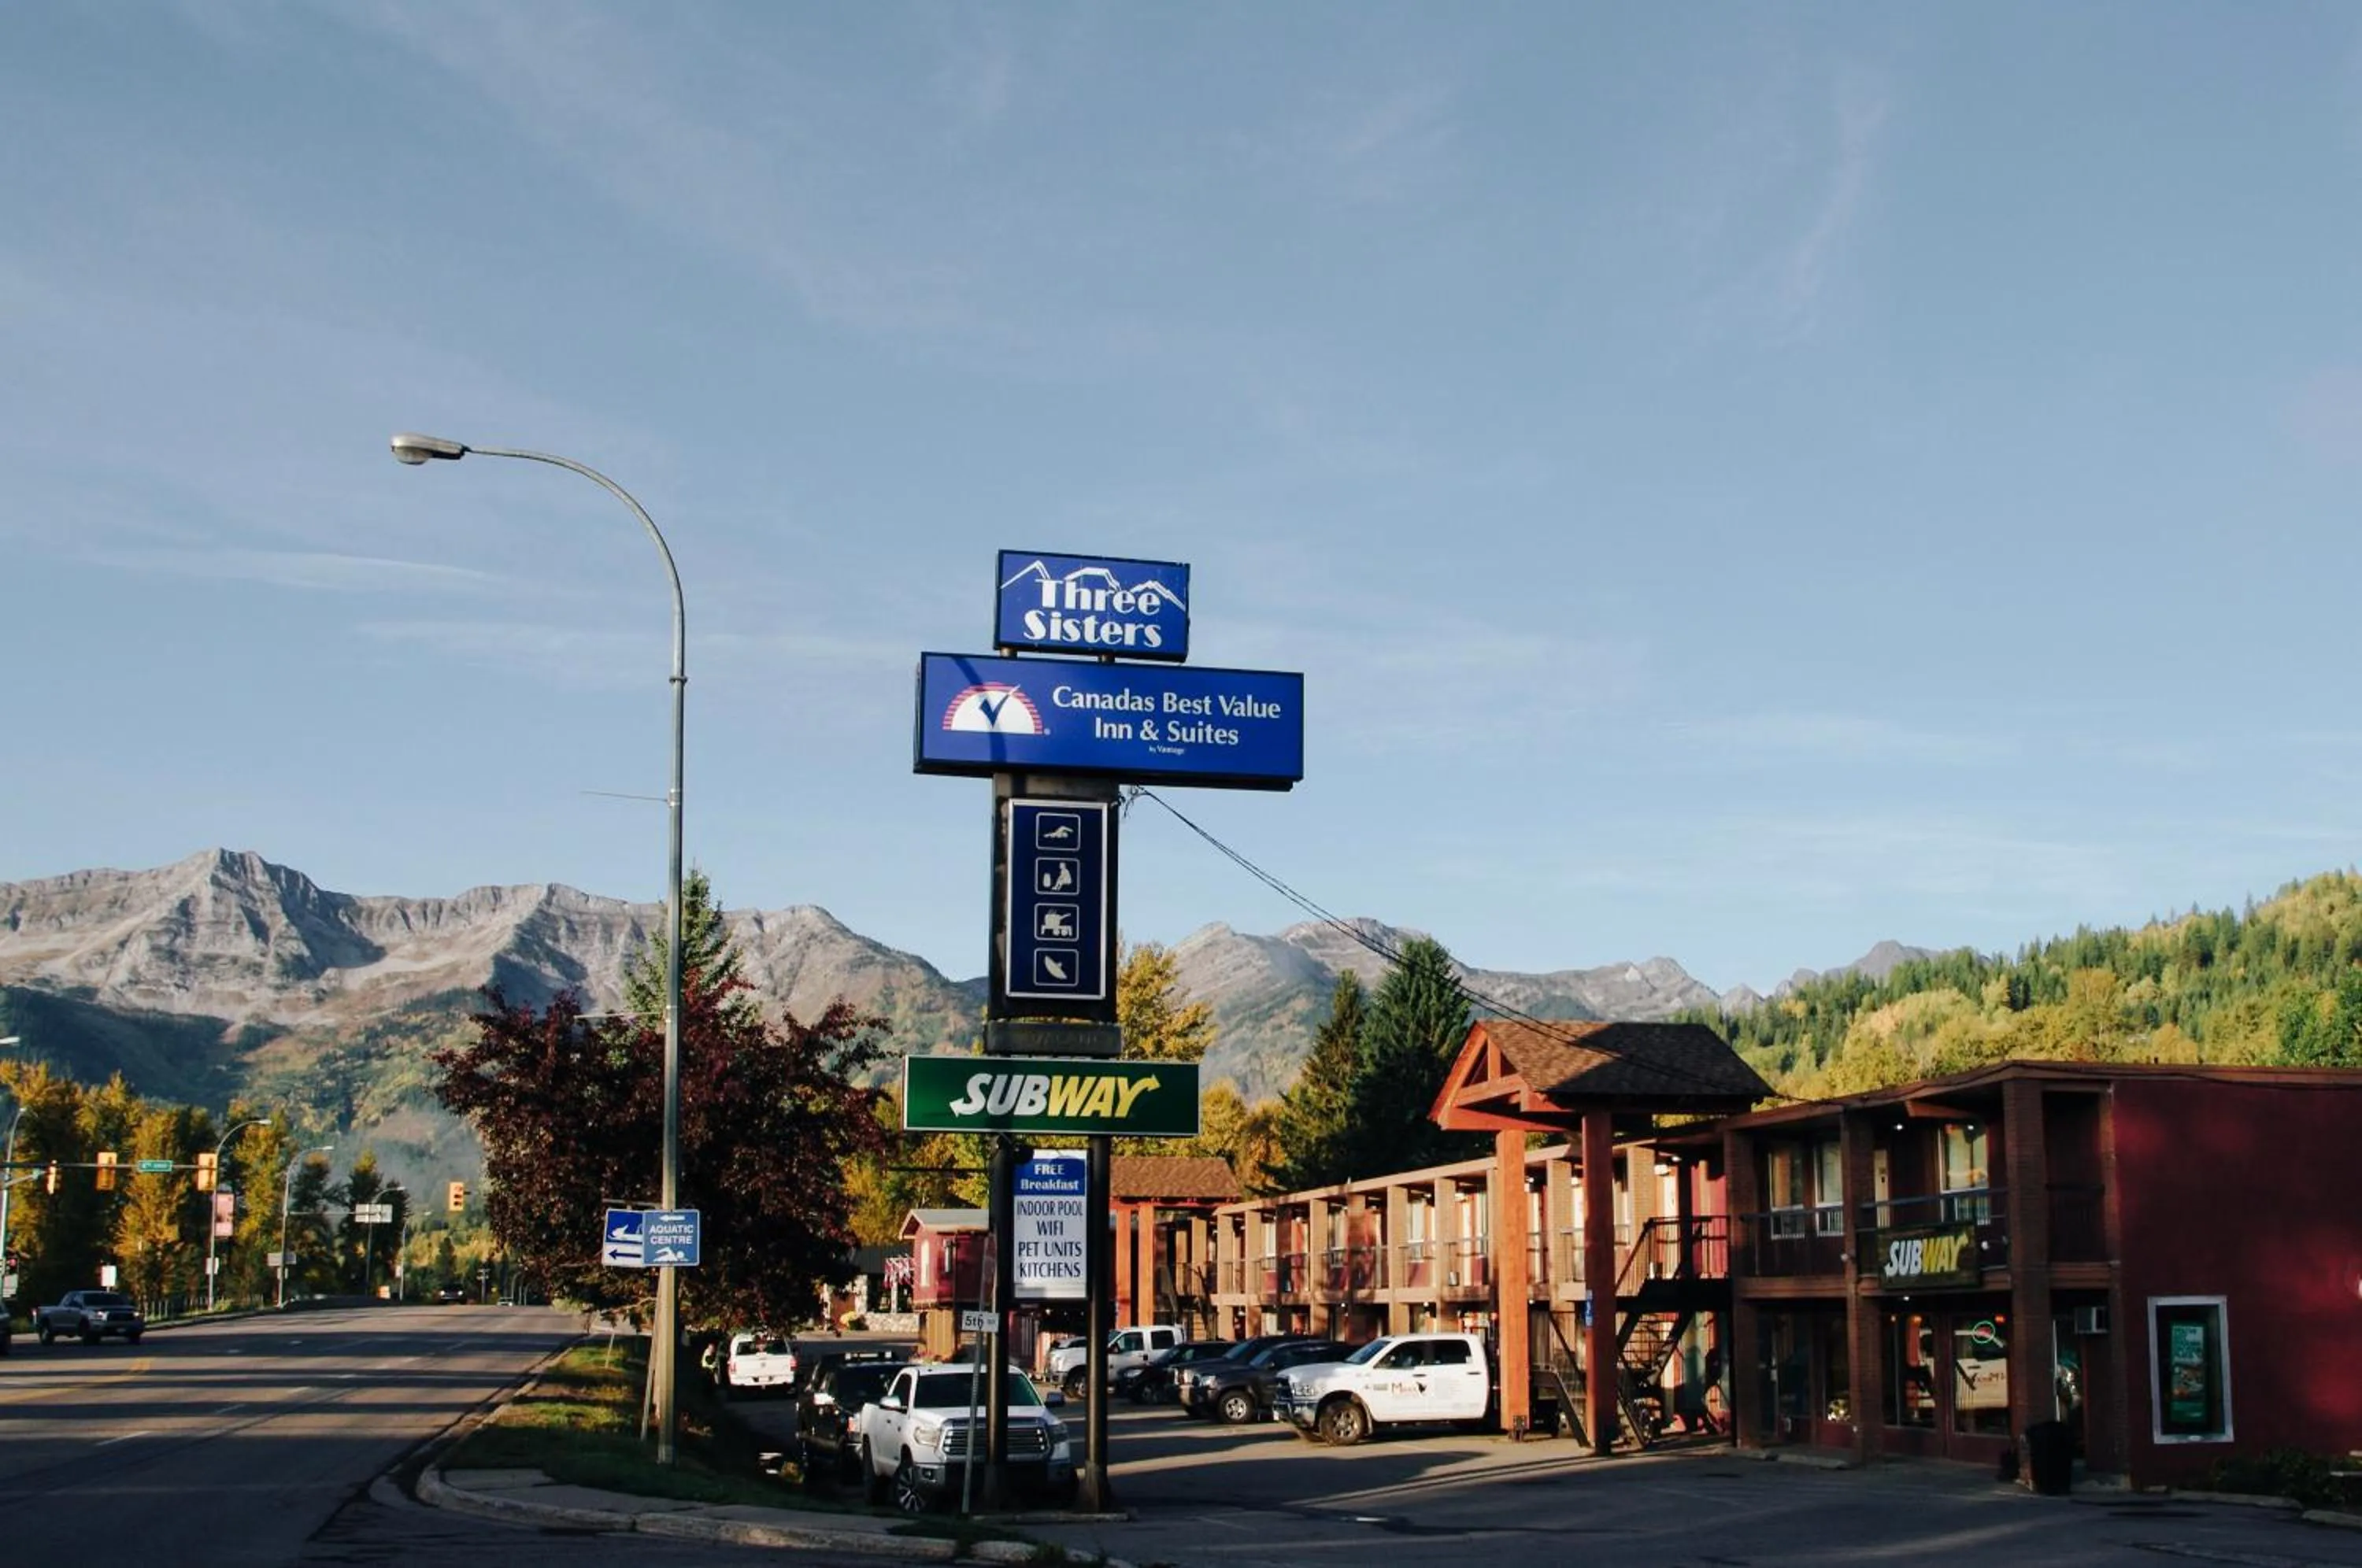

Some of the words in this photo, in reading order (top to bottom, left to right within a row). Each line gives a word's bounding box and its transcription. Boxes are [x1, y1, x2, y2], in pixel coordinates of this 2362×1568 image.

[1035, 578, 1161, 616] Three
[1024, 609, 1162, 649] Sisters
[1052, 685, 1155, 712] Canadas
[1162, 691, 1213, 716] Best
[1218, 694, 1282, 719] Value
[1094, 716, 1133, 741] Inn
[1139, 719, 1160, 741] &
[1167, 719, 1239, 745] Suites
[950, 1072, 1161, 1119] SUBWAY
[1034, 1163, 1065, 1175] FREE
[1020, 1178, 1079, 1191] Breakfast
[1017, 1200, 1055, 1216] INDOOR
[1057, 1200, 1083, 1216] POOL
[648, 1224, 694, 1234] AQUATIC
[1036, 1219, 1064, 1236] WIFI
[650, 1235, 693, 1244] CENTRE
[1018, 1241, 1038, 1257] PET
[1045, 1241, 1083, 1257] UNITS
[1884, 1232, 1968, 1277] SUBWAY
[1020, 1262, 1081, 1278] KITCHENS
